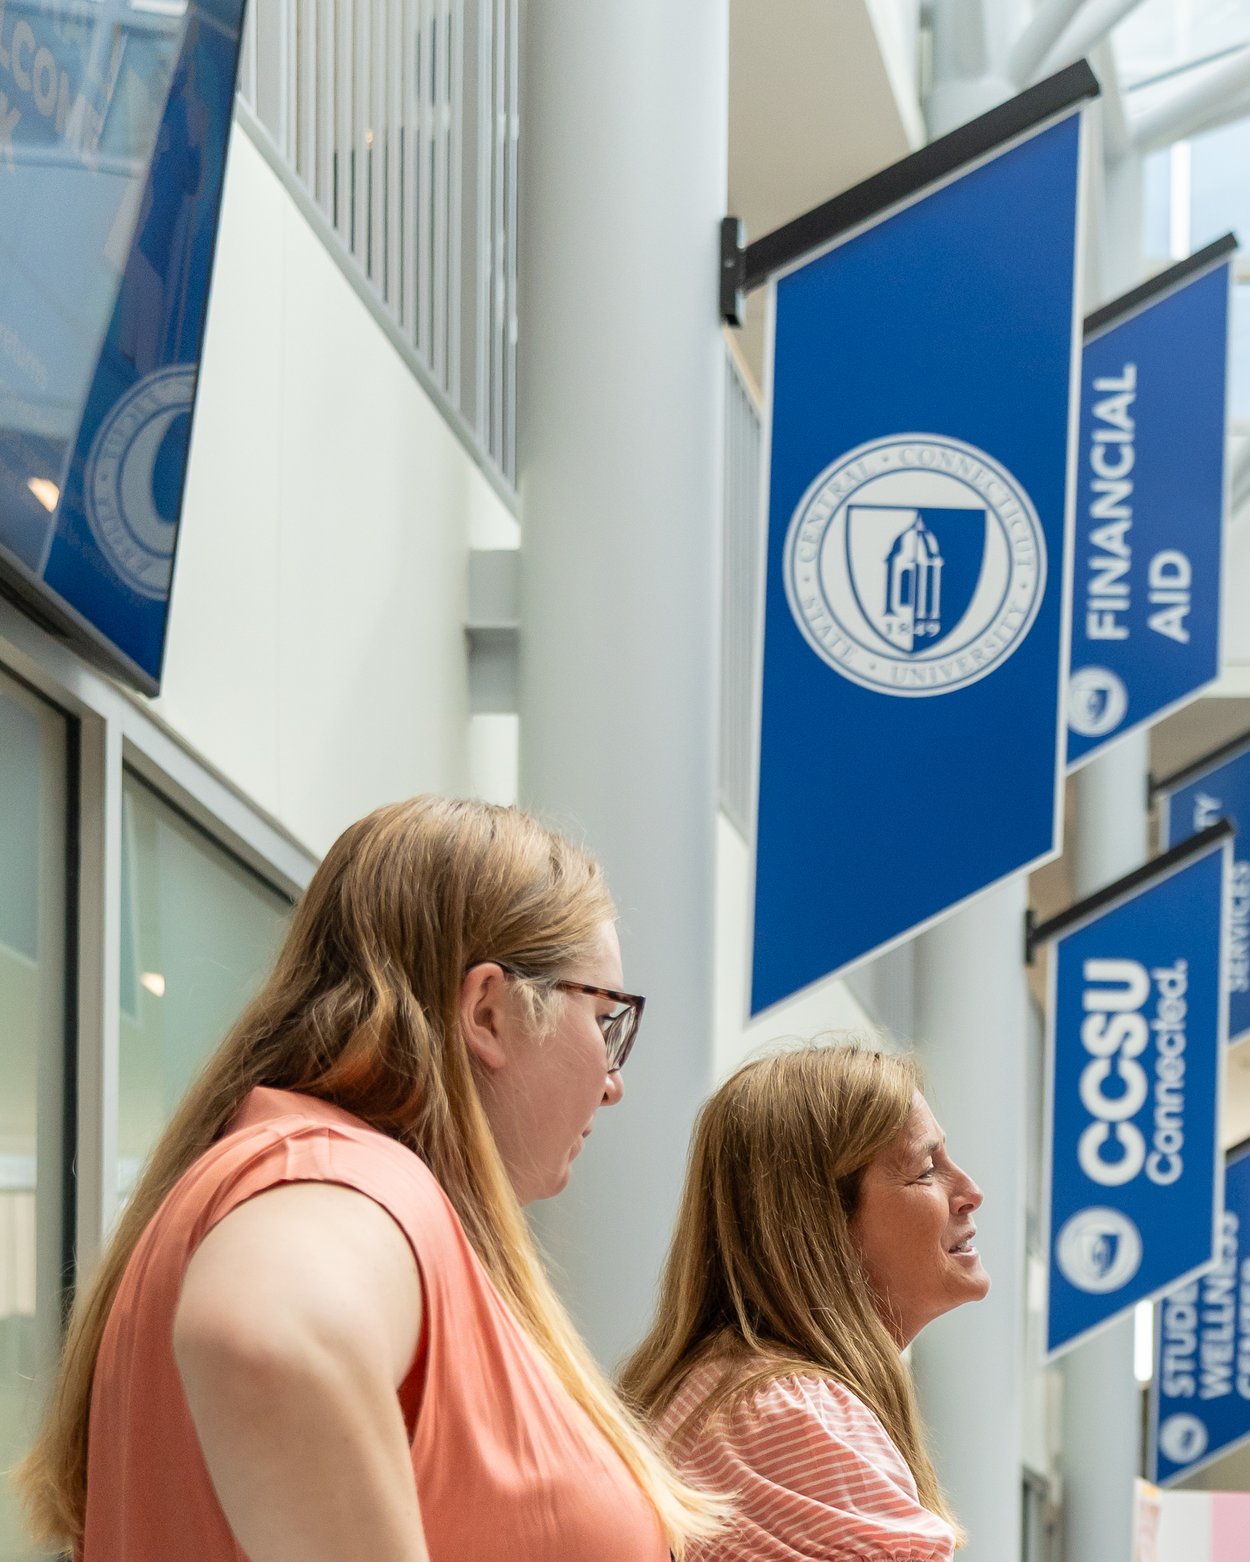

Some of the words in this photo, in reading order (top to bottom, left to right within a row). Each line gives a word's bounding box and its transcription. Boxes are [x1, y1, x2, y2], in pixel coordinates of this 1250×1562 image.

[799, 459, 875, 564] CENTRAL
[898, 448, 1035, 570] CONNECTICUT
[1085, 362, 1137, 641] FINANCIAL
[801, 595, 858, 661] STATE
[889, 598, 1028, 687] UNIVERSITY
[883, 622, 941, 639] 1849
[1146, 548, 1192, 645] AID
[1077, 958, 1151, 1187] CCSU
[1145, 957, 1189, 1186] Connected.
[1162, 1278, 1199, 1398] STUDE
